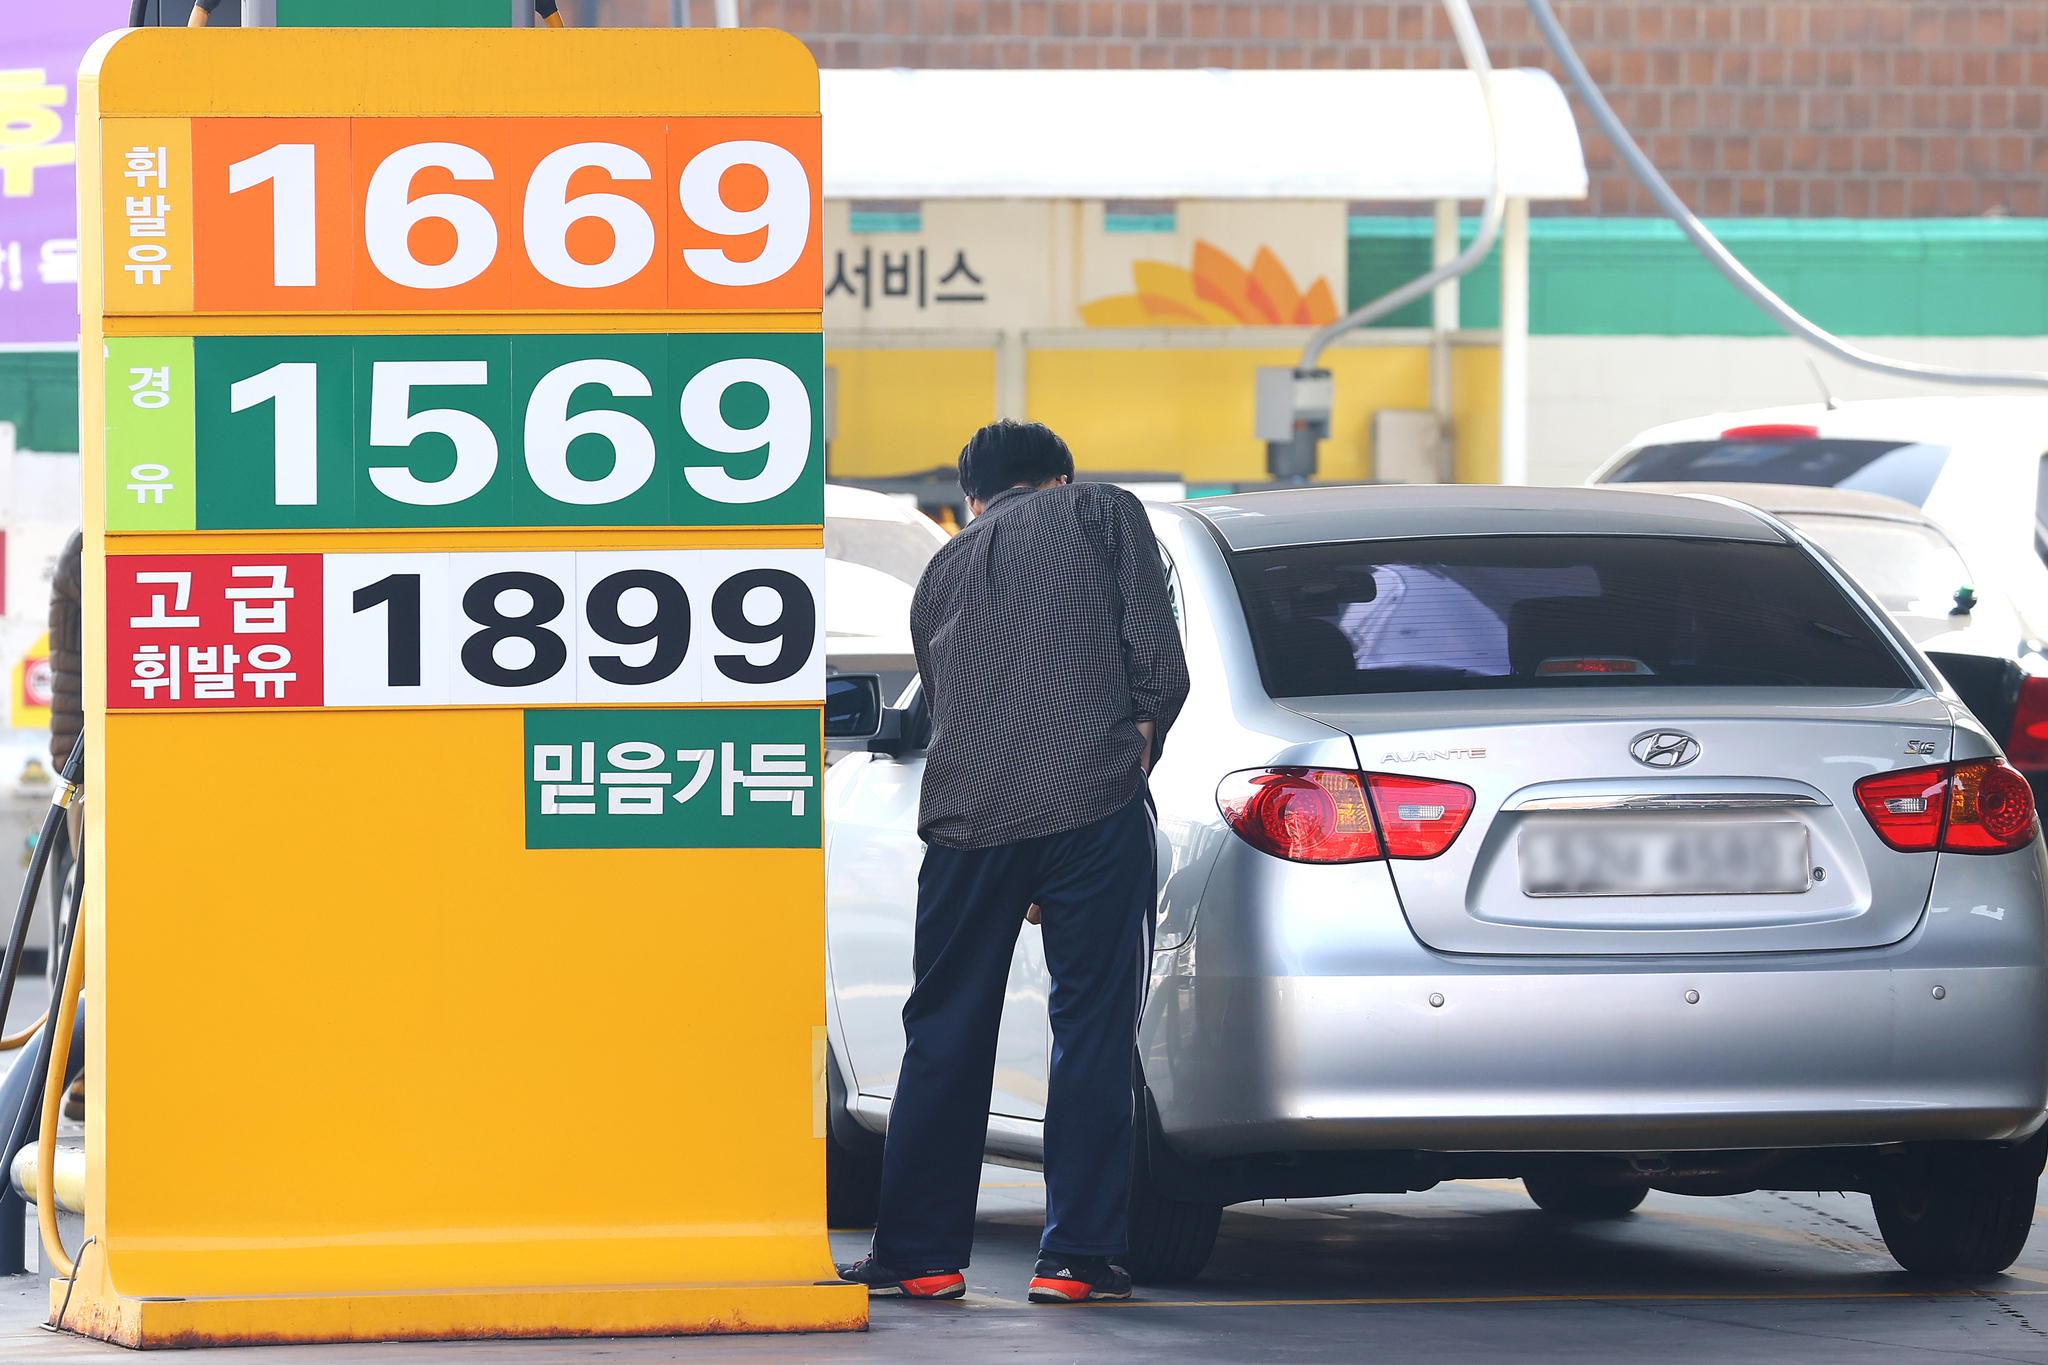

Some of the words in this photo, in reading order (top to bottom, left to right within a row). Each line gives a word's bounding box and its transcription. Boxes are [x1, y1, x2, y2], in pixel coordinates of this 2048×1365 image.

[123, 146, 172, 286] 휘발유
[228, 140, 811, 290] 1669
[826, 248, 985, 308] 서비스
[230, 358, 812, 506] 1569
[130, 644, 297, 700] 휘발유
[352, 568, 816, 688] 1899
[533, 741, 814, 816] 믿음가득
[1380, 747, 1487, 764] AVANTE
